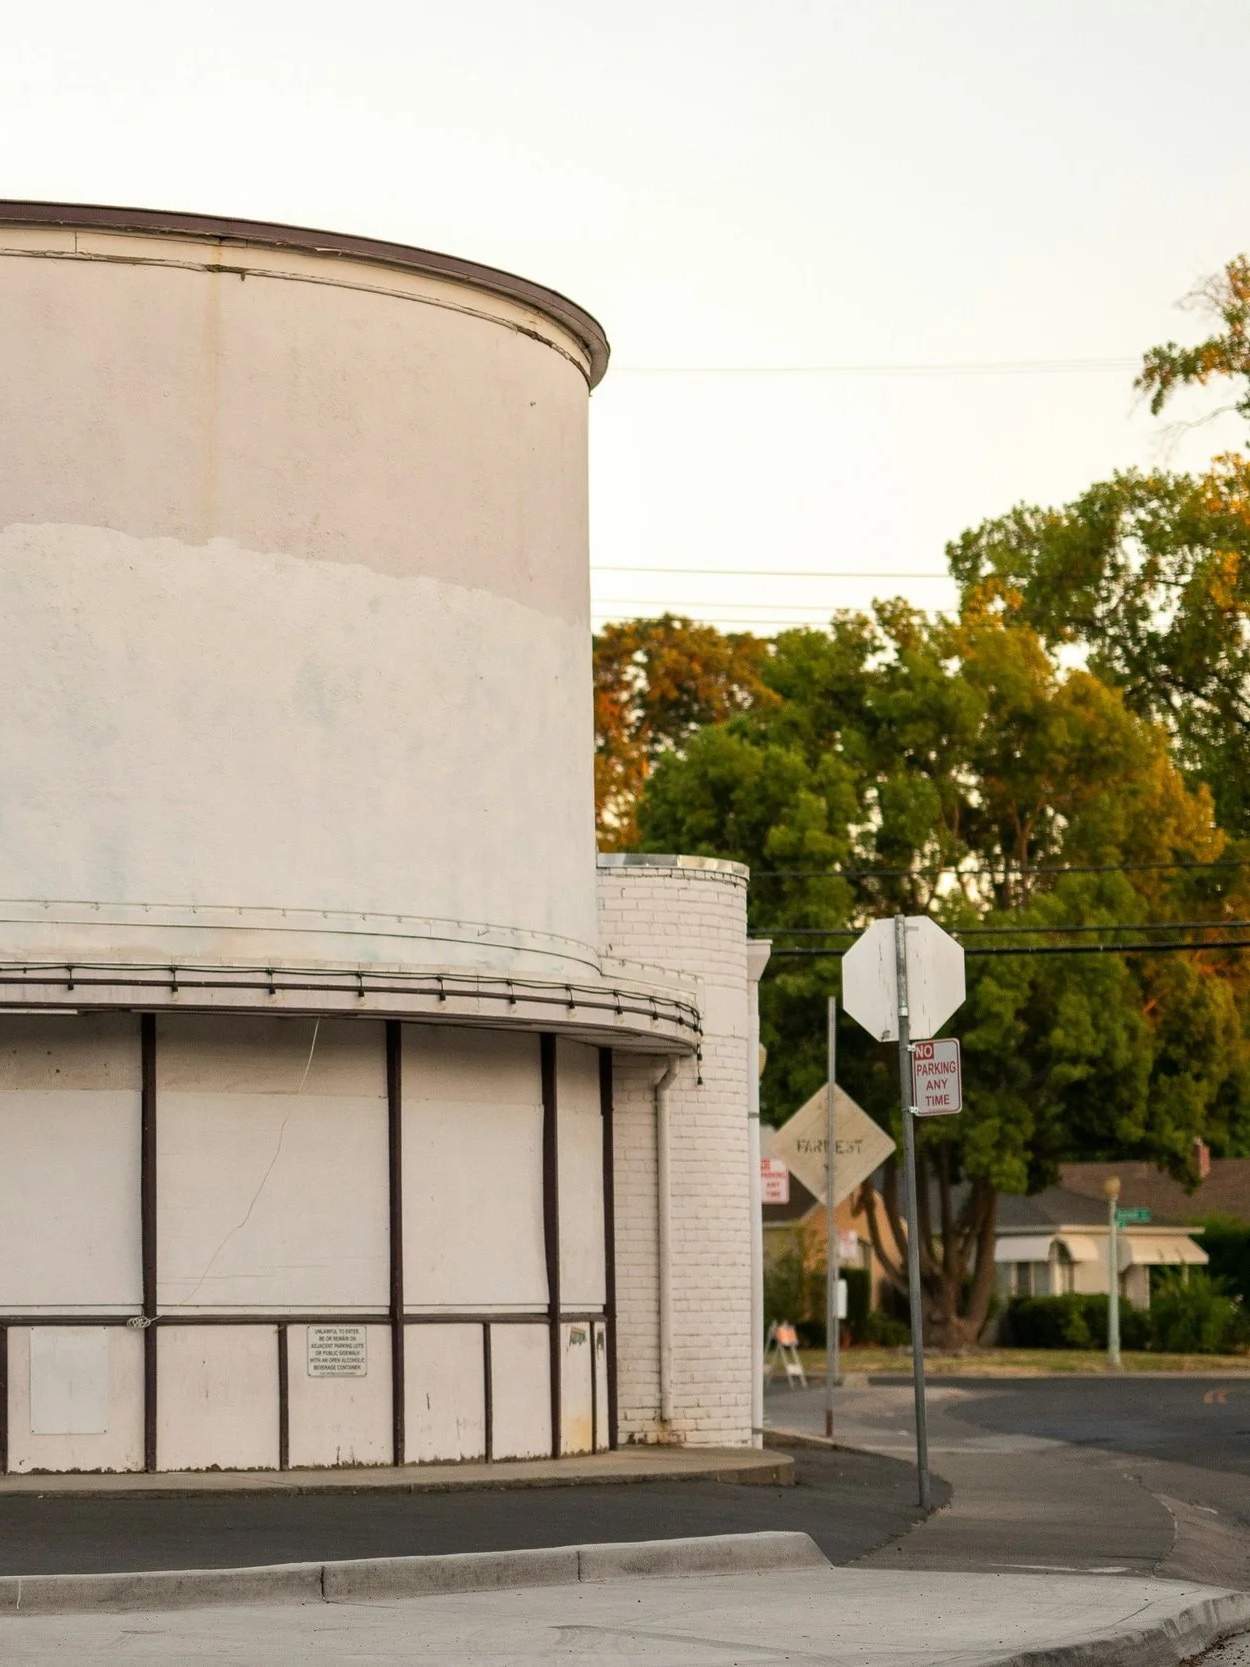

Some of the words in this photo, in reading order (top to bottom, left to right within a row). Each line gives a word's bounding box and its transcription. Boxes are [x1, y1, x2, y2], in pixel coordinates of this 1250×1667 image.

[916, 1045, 933, 1059] NO
[917, 1061, 956, 1076] PARKING
[926, 1079, 948, 1091] ANY
[926, 1094, 950, 1106] TIME
